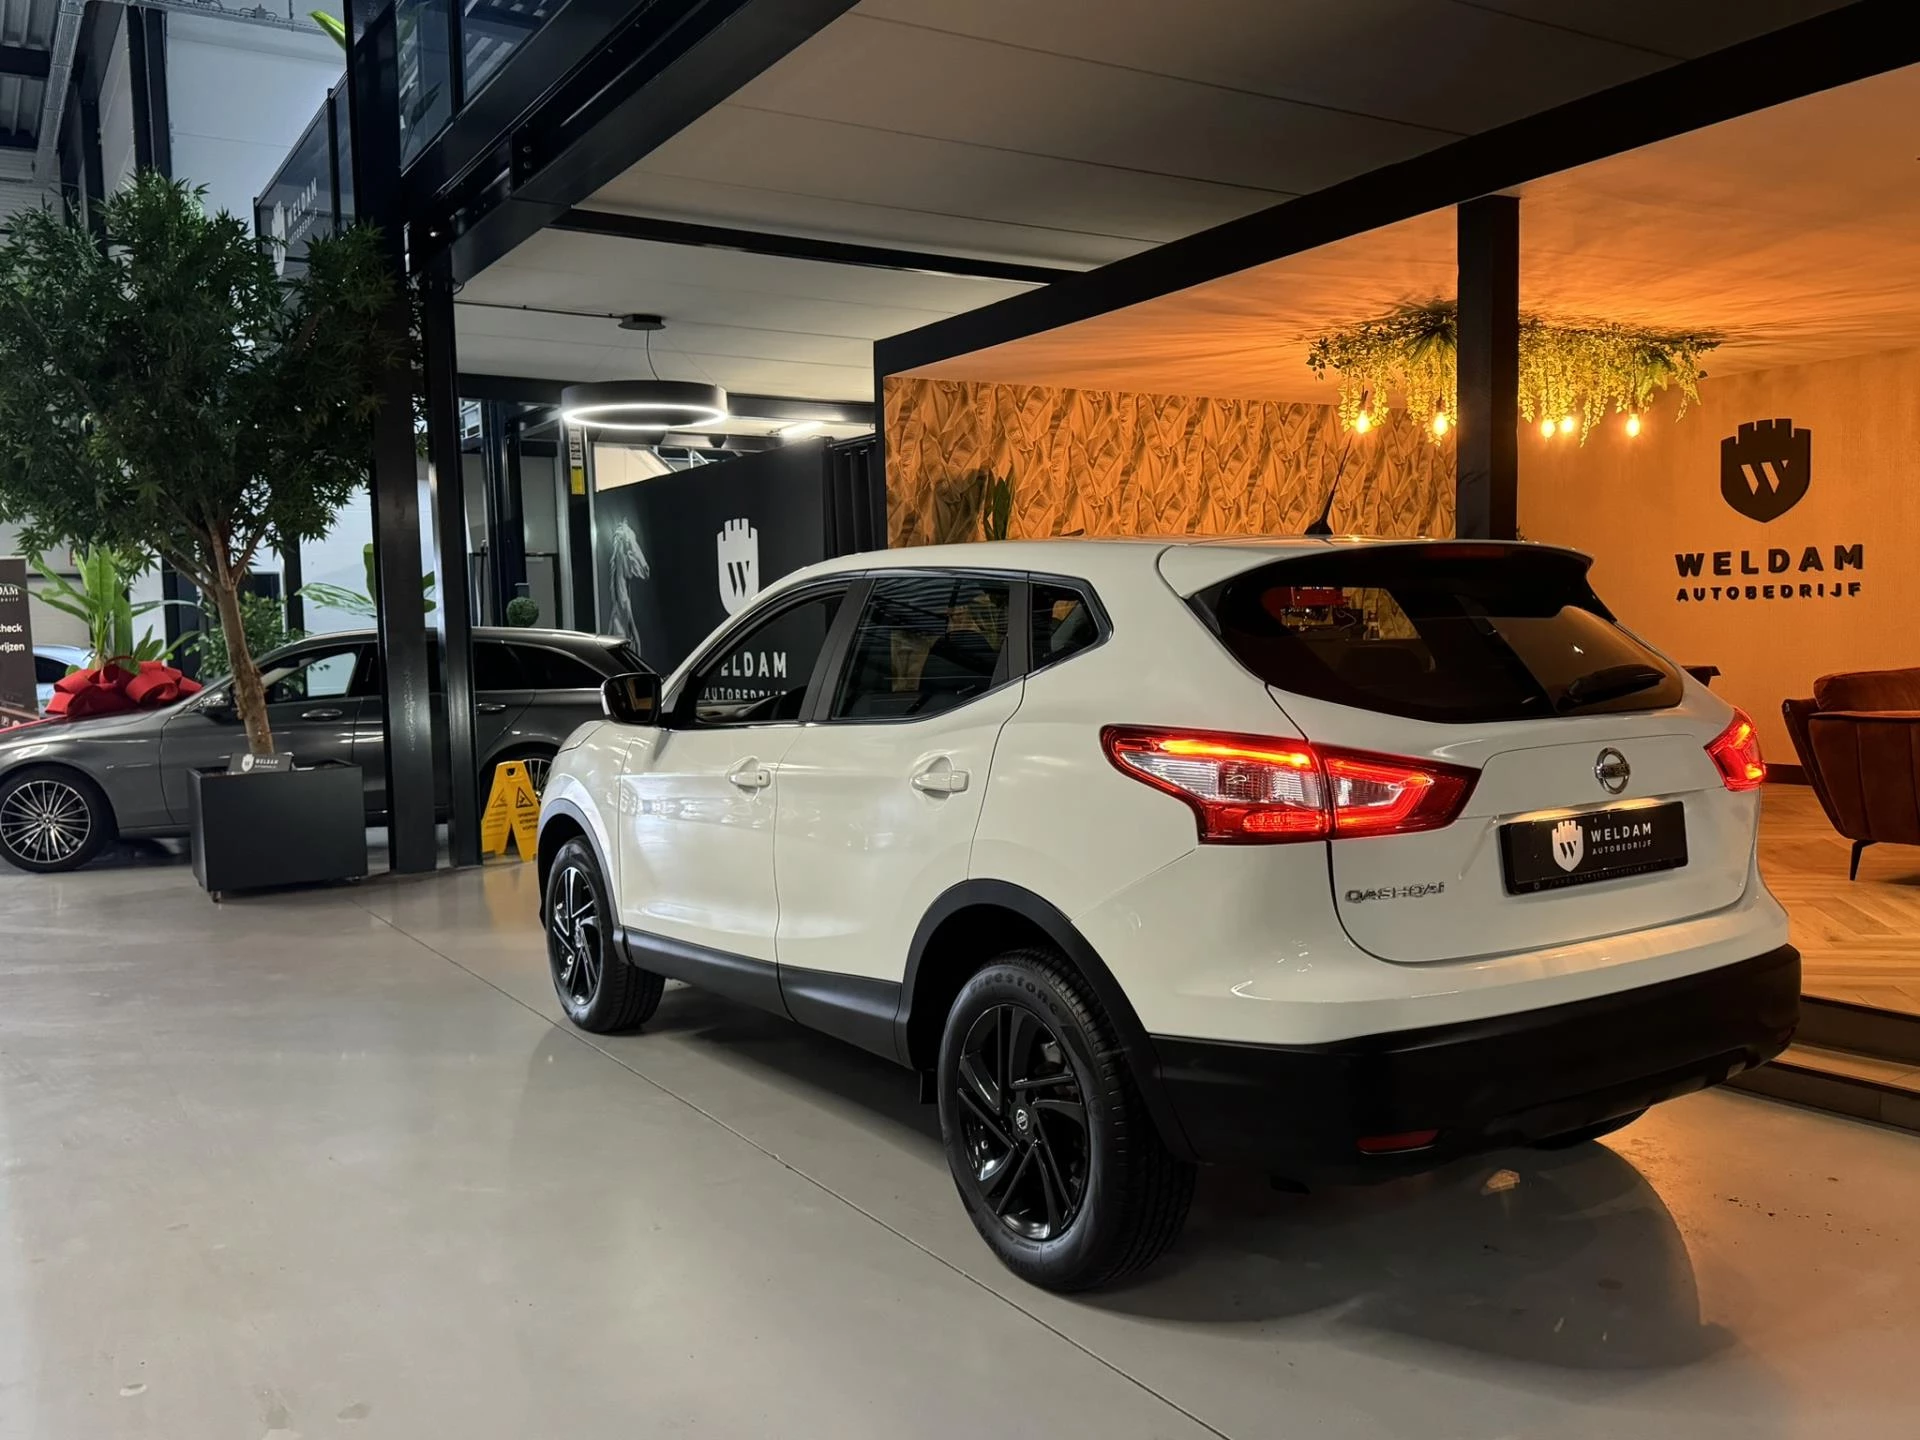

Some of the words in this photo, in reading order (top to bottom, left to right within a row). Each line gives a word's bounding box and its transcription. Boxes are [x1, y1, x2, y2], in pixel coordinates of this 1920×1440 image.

[1740, 460, 1789, 496] W
[1674, 544, 1863, 578] WELDAM
[727, 560, 750, 597] W
[1676, 582, 1861, 602] AUTOBEDRIJF
[0, 623, 23, 632] heck
[0, 641, 25, 653] rijzen
[721, 651, 787, 678] LDAM
[1590, 822, 1652, 843] WELDAM
[1592, 839, 1652, 856] AUTOBEDRIJF
